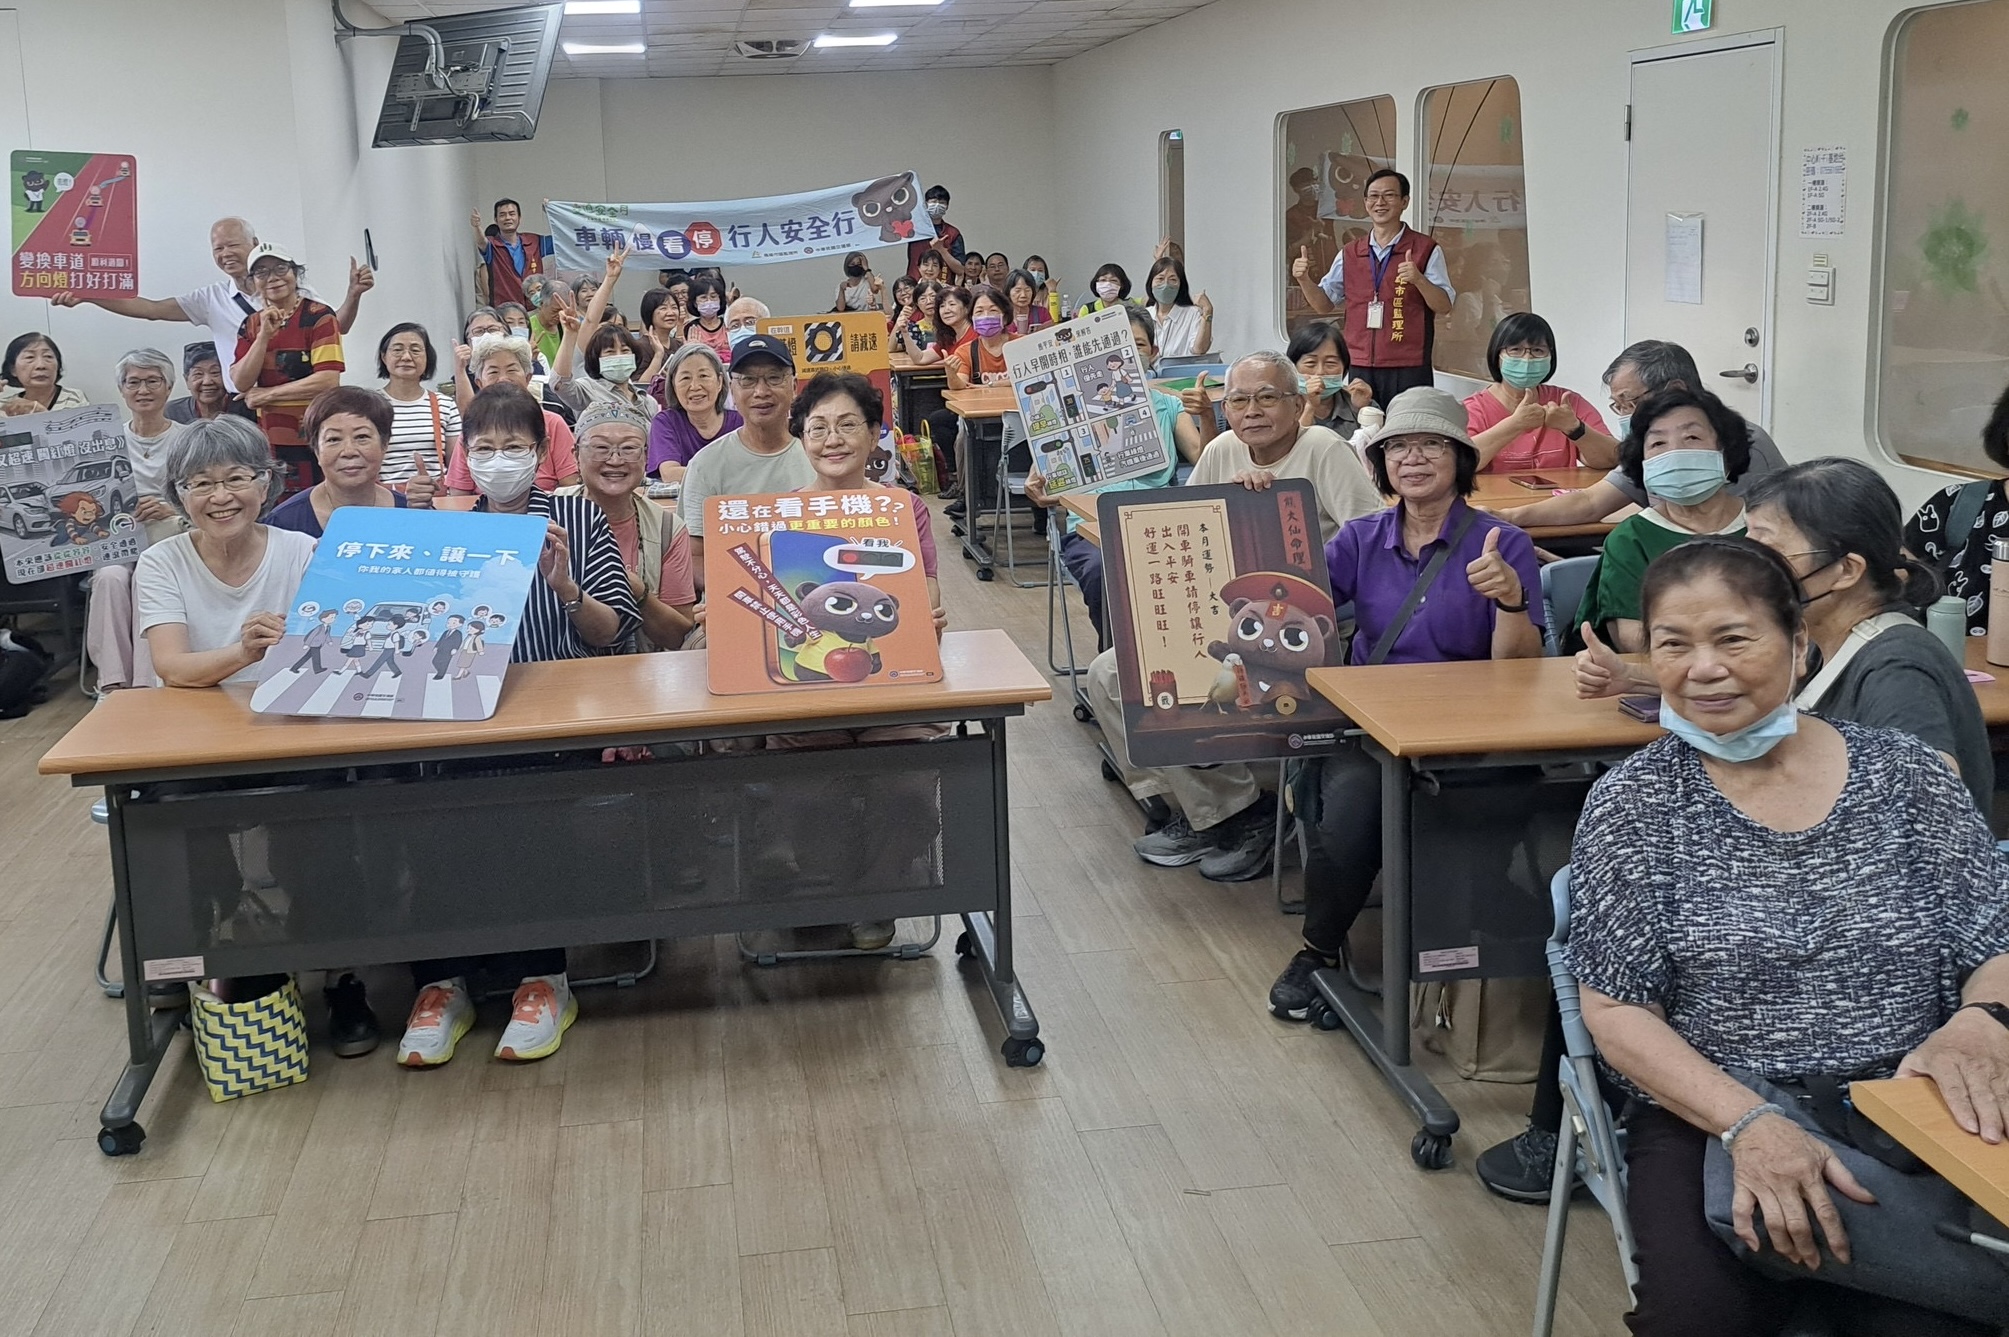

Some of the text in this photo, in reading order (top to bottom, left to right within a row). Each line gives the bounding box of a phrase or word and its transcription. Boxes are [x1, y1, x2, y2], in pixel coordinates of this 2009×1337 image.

[728, 210, 855, 248] 行人安全行
[19, 252, 85, 270] 變換車道
[19, 271, 134, 290] 方向燈打好打滿
[850, 332, 878, 352] 請減速
[718, 494, 905, 521] 還在看手機？？
[719, 516, 899, 534] 小心錯過更重要的顏色！
[336, 541, 520, 566] 停下來、讓一下
[863, 538, 891, 548] 看我
[1161, 525, 1179, 585] 出入平安
[358, 564, 482, 579] 你我的家人都值得被守護
[1144, 527, 1169, 648] 好運一路旺旺旺！
[1177, 523, 1207, 659] 開車騎車請停讓行人
